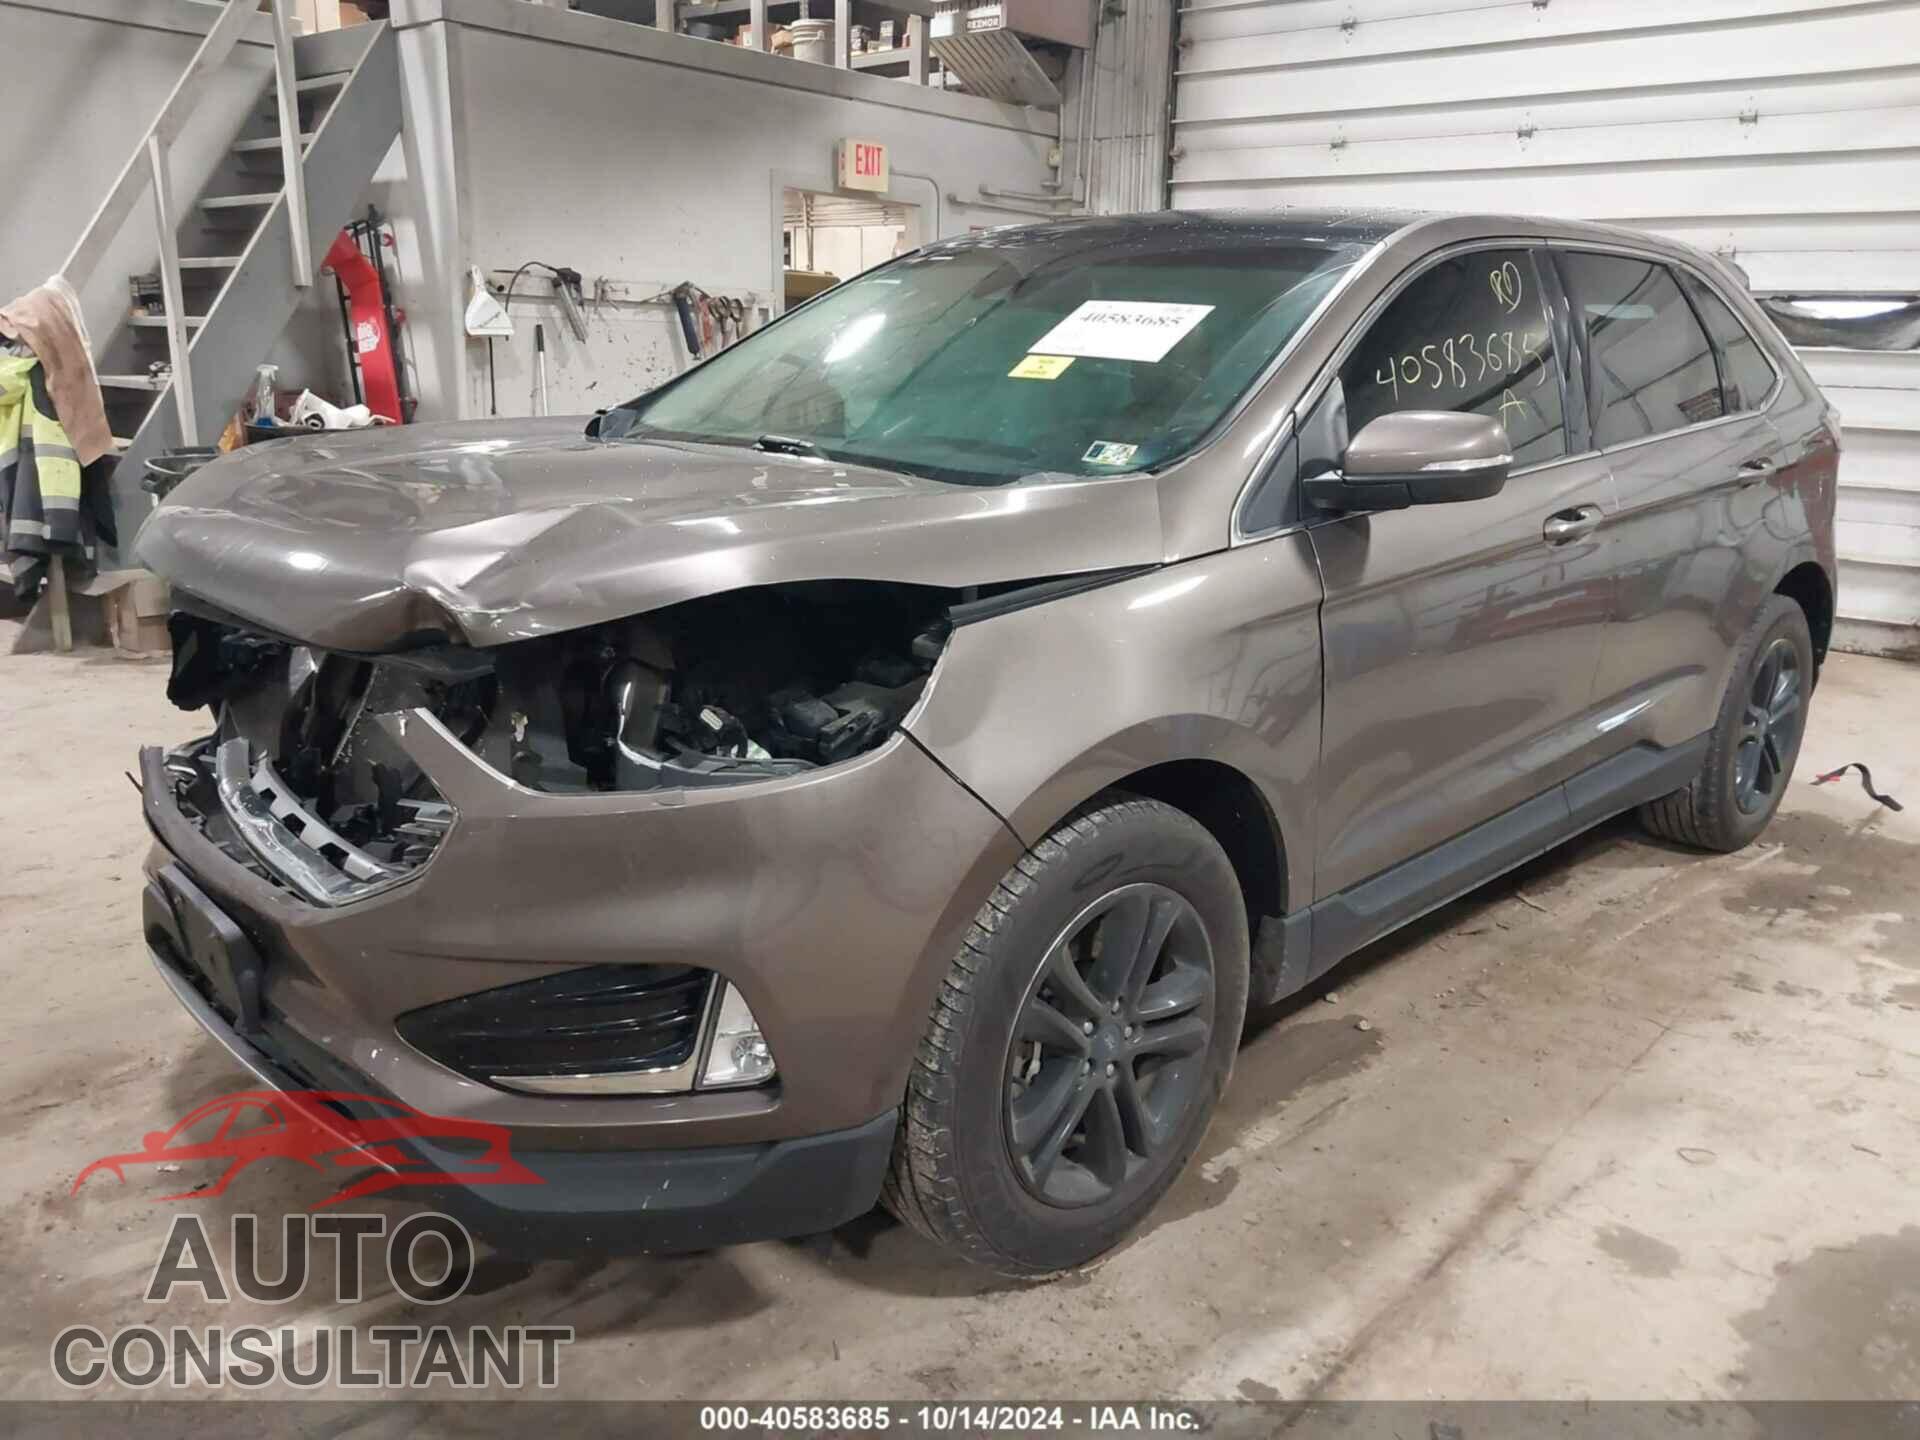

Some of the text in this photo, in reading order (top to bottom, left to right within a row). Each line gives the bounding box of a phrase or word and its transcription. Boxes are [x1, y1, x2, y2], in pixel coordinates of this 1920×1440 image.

[855, 144, 883, 176] EXIT
[1081, 310, 1185, 328] 40583685
[1375, 331, 1547, 404] 40583685
[1498, 387, 1527, 429] A
